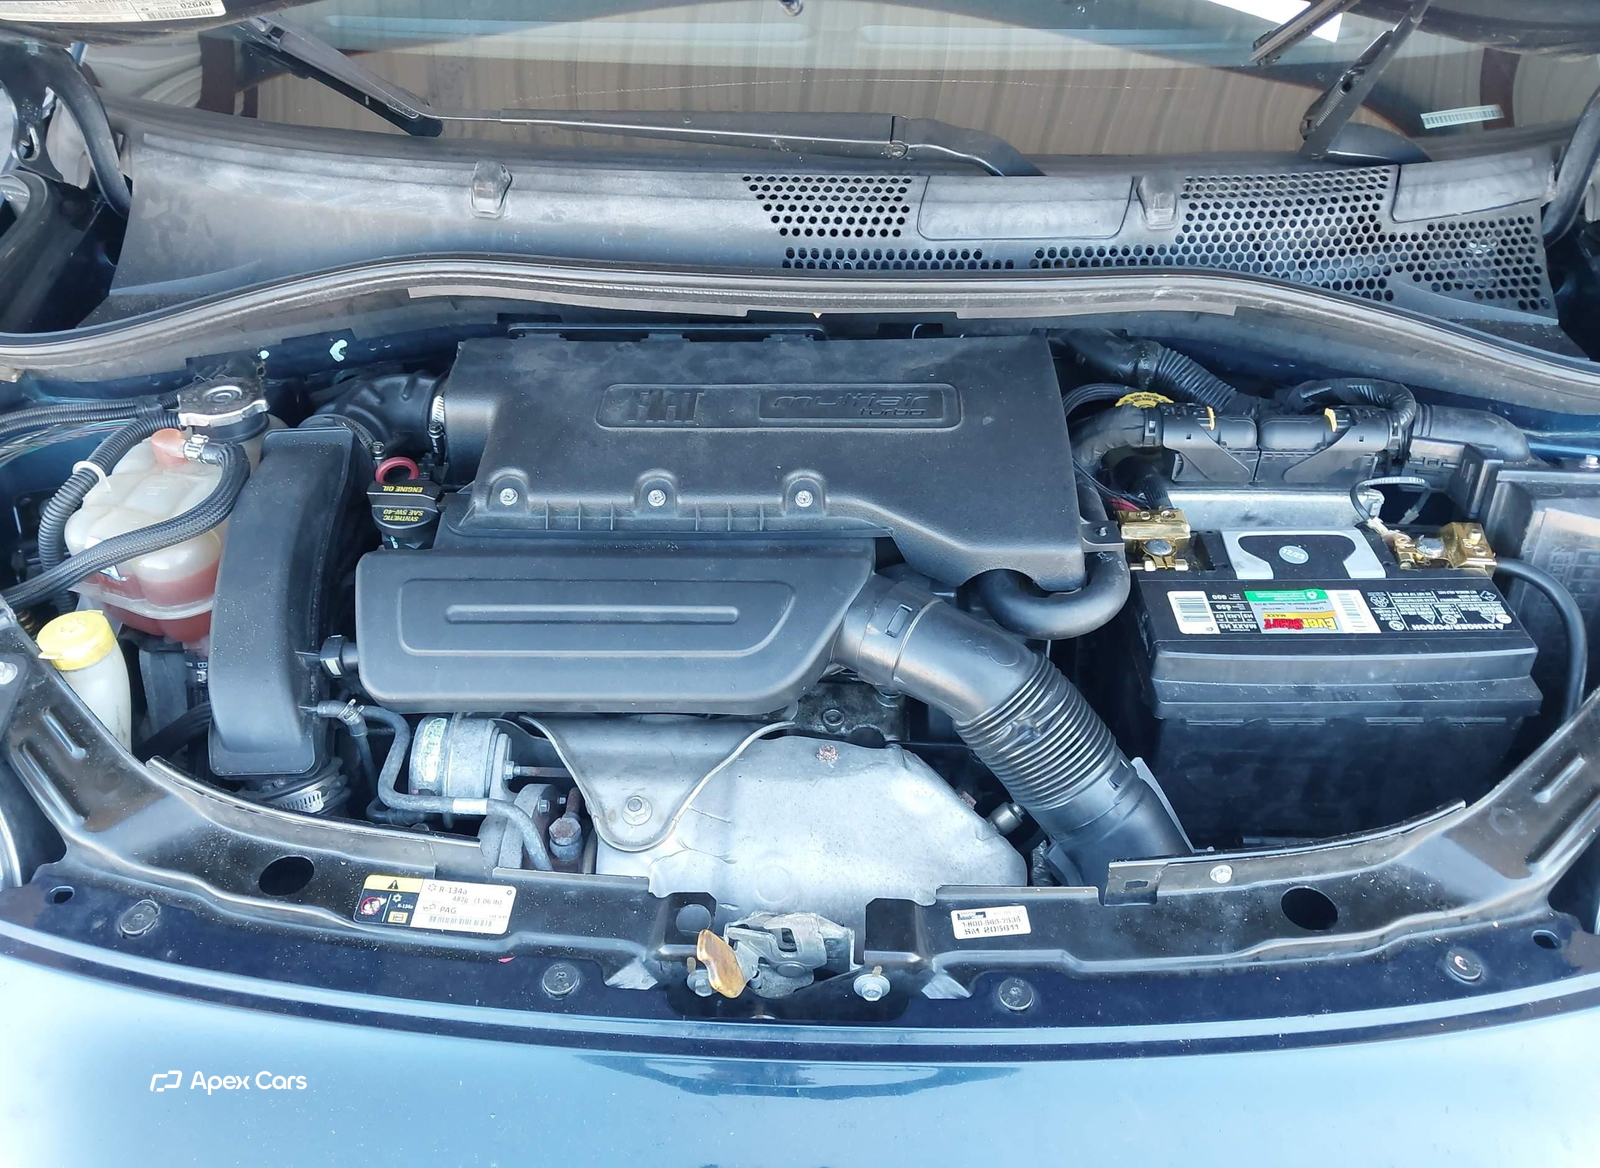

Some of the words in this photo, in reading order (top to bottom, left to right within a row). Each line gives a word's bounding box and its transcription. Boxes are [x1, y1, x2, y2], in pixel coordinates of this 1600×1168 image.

[773, 392, 930, 408] multiair
[859, 407, 926, 416] turbo
[382, 508, 407, 516] 5W-40
[1263, 617, 1339, 631] EverStart
[1411, 623, 1497, 631] DANGER/POISON
[438, 886, 468, 896] R-134a
[439, 906, 457, 915] PAG
